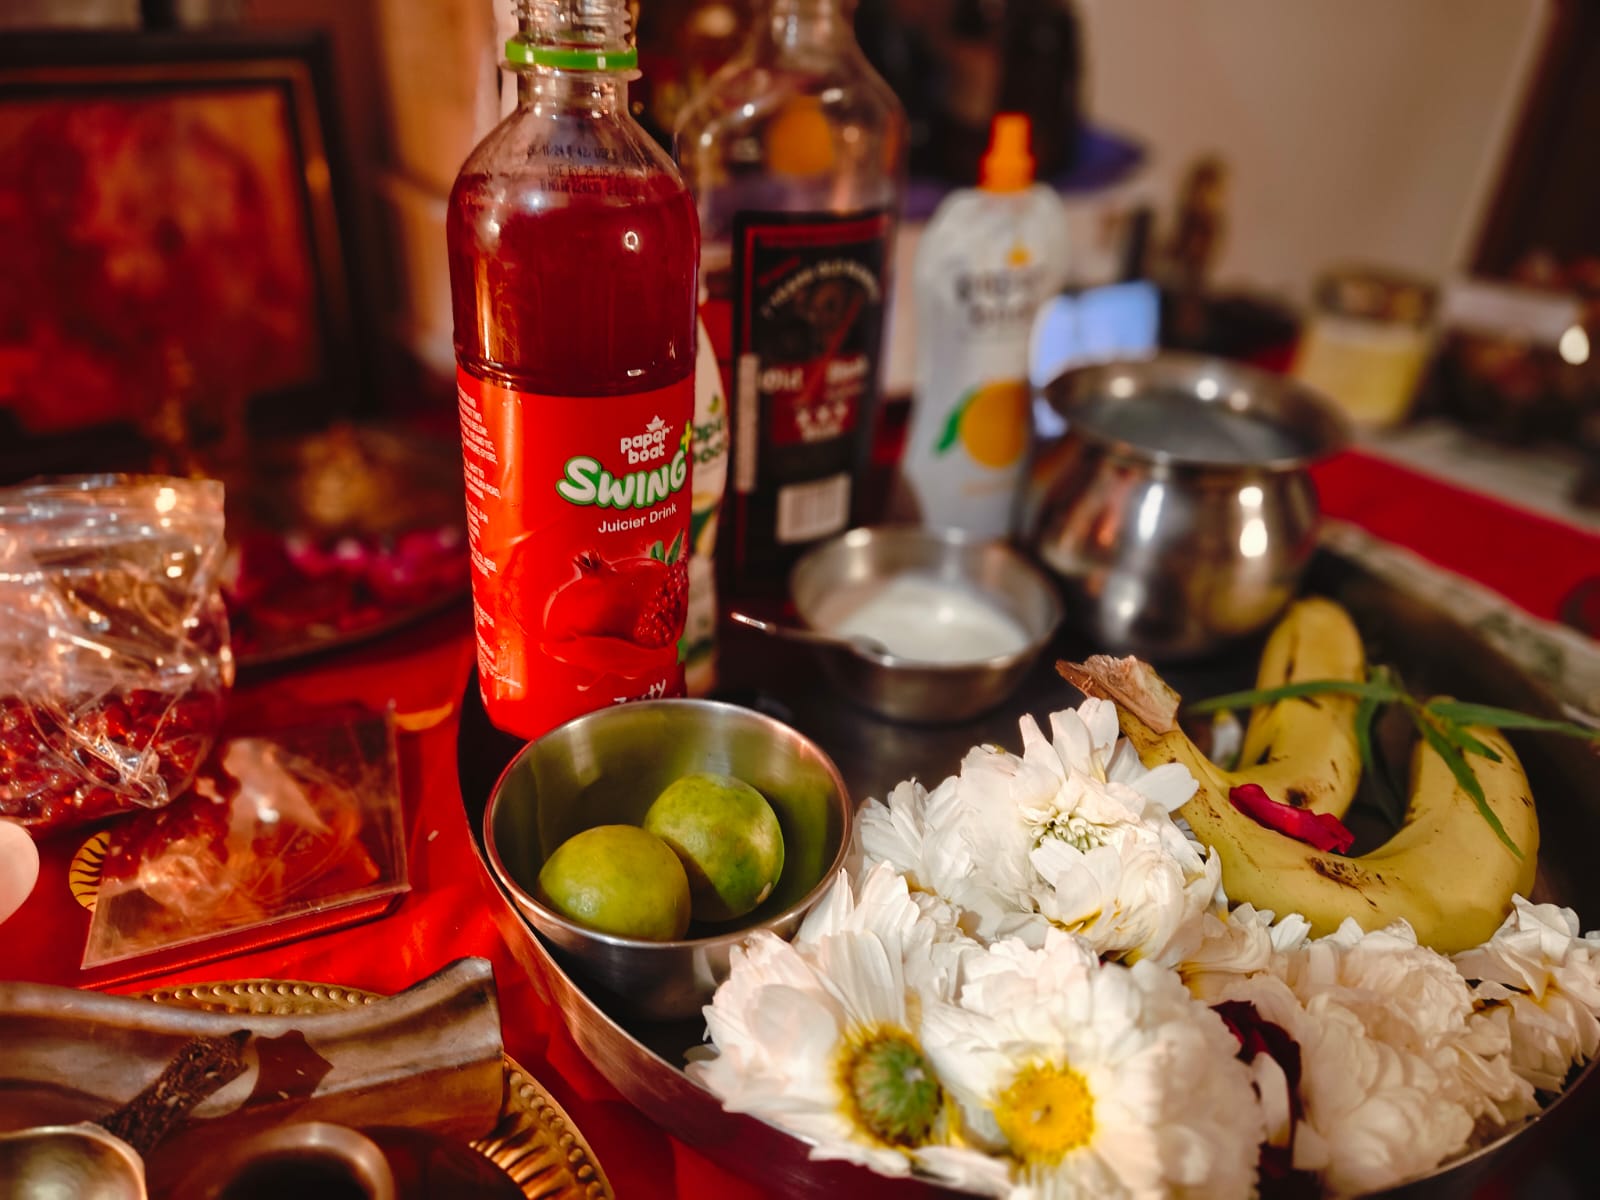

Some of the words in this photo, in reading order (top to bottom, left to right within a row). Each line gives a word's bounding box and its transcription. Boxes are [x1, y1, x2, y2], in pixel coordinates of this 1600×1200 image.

[620, 427, 670, 454] paper
[628, 443, 665, 464] boat
[556, 450, 687, 509] SWING
[598, 516, 646, 533] Juicier
[649, 503, 677, 523] Drink
